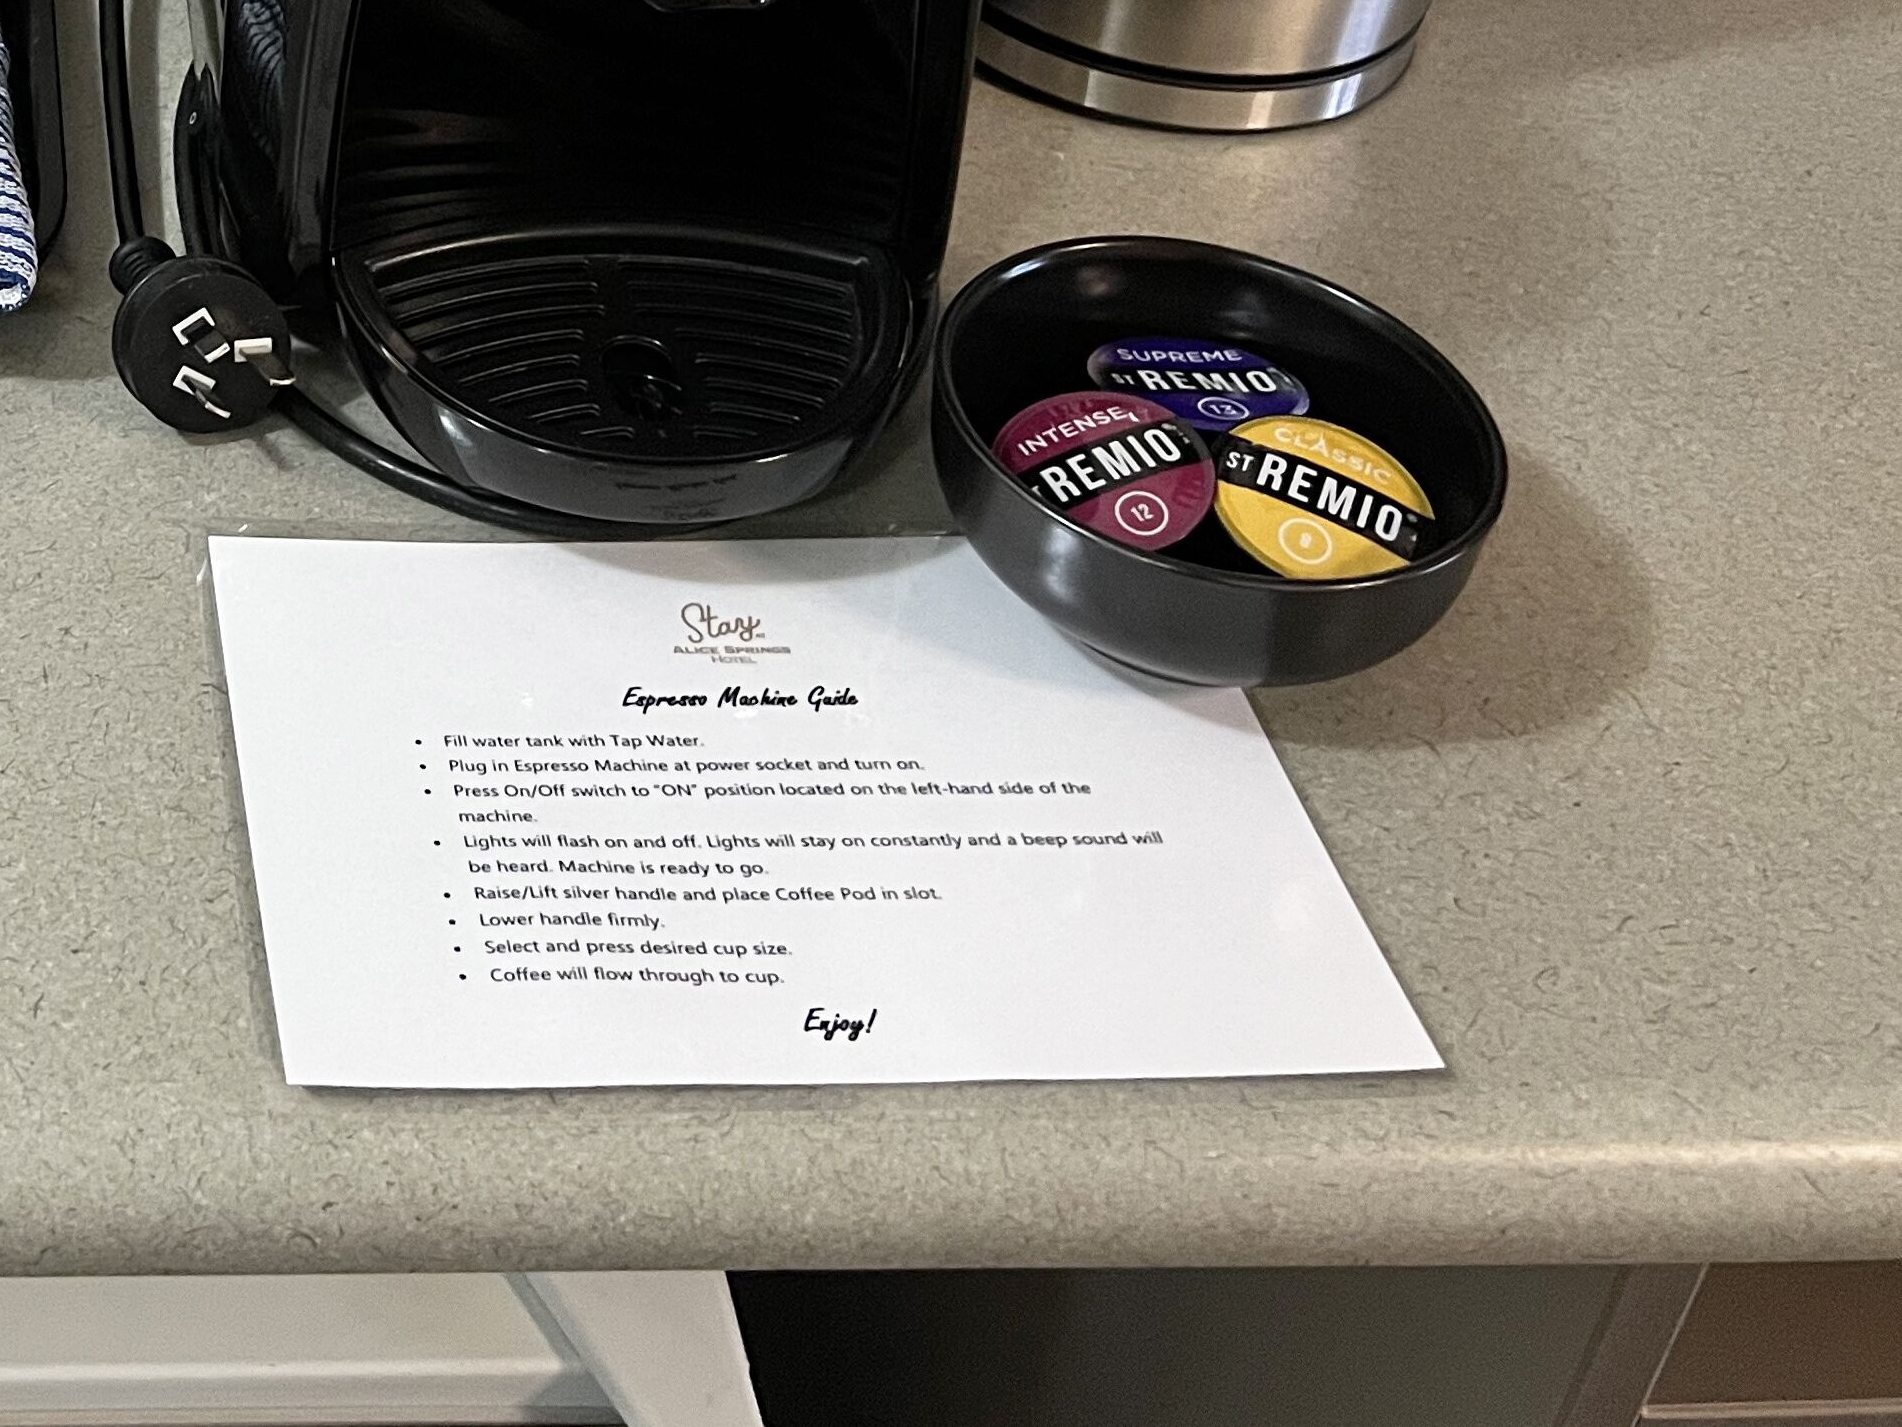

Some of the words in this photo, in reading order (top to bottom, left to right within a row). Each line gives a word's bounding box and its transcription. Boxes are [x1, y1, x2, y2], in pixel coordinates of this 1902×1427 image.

[1115, 348, 1243, 364] SUPREME
[1136, 369, 1277, 394] REMIO
[1016, 405, 1127, 456] INTENSE
[1039, 428, 1182, 503] REMIO
[1273, 426, 1393, 485] CLASSIC
[1226, 451, 1255, 472] ST
[1256, 452, 1404, 543] REMIO
[1129, 503, 1155, 523] 12
[680, 601, 762, 644] Stay
[673, 645, 720, 655] ALICE
[724, 645, 792, 655] SPRINGS
[621, 685, 708, 716] Espresso
[716, 685, 799, 709] Machine
[807, 685, 860, 713] Guide
[443, 734, 468, 748] Fill
[471, 736, 521, 748] water
[524, 734, 565, 748] tank
[567, 733, 606, 748] with
[608, 734, 643, 751] Tap
[645, 734, 705, 748] Water.
[448, 758, 488, 777] Plug
[491, 758, 510, 773] in
[513, 758, 590, 776] Espresso
[593, 758, 669, 773] Machine
[673, 759, 692, 772] at
[695, 761, 751, 775] power
[754, 757, 814, 772] socket
[816, 757, 851, 772] and
[854, 759, 892, 771] turn
[896, 760, 926, 771] on.
[453, 783, 500, 798] Press
[503, 783, 566, 799] On/Off
[570, 783, 627, 798] switch
[630, 785, 651, 798] to
[703, 782, 776, 801] position
[778, 782, 846, 796] located
[849, 785, 874, 796] on
[876, 781, 908, 796] the
[910, 781, 995, 796] left-hand
[997, 781, 1035, 795] side
[1038, 780, 1057, 795] of
[1060, 781, 1092, 795] the
[458, 808, 539, 823] machine.
[463, 834, 518, 852] Lights
[520, 833, 552, 848] will
[556, 833, 601, 849] flash
[603, 838, 629, 849] on
[633, 834, 667, 849] and
[671, 833, 703, 849] off.
[705, 833, 761, 852] Lights
[763, 833, 796, 848] will
[800, 835, 836, 852] stay
[840, 836, 866, 848] on
[870, 832, 962, 851] constantly
[967, 832, 1002, 847] and
[1006, 835, 1019, 847] a
[1020, 831, 1068, 849] beep
[1071, 831, 1129, 846] sound
[1131, 830, 1164, 845] will
[467, 859, 492, 874] be
[495, 858, 554, 874] heard.
[557, 859, 636, 875] Machine
[639, 860, 656, 875] is
[659, 860, 710, 879] ready
[714, 862, 735, 875] to
[739, 863, 770, 879] go.
[473, 884, 559, 901] Raise/Lift
[562, 885, 610, 900] silver
[614, 885, 677, 902] handle
[682, 886, 717, 902] and
[721, 886, 771, 905] place
[774, 886, 836, 902] Coffee
[839, 886, 877, 901] Pod
[880, 886, 899, 901] in
[902, 885, 943, 900] slot.
[478, 912, 535, 928] Lower
[538, 911, 603, 927] handle
[606, 911, 666, 932] firmly.
[484, 939, 541, 955] Select
[545, 938, 581, 953] and
[585, 942, 636, 957] press
[639, 939, 709, 956] desired
[712, 944, 748, 959] cup
[752, 940, 793, 956] size.
[489, 966, 552, 983] Coffee
[555, 965, 589, 981] will
[593, 965, 634, 982] flow
[638, 966, 715, 987] through
[718, 970, 740, 984] to
[744, 972, 785, 988] cup.
[802, 1006, 879, 1042] Enjoy!
